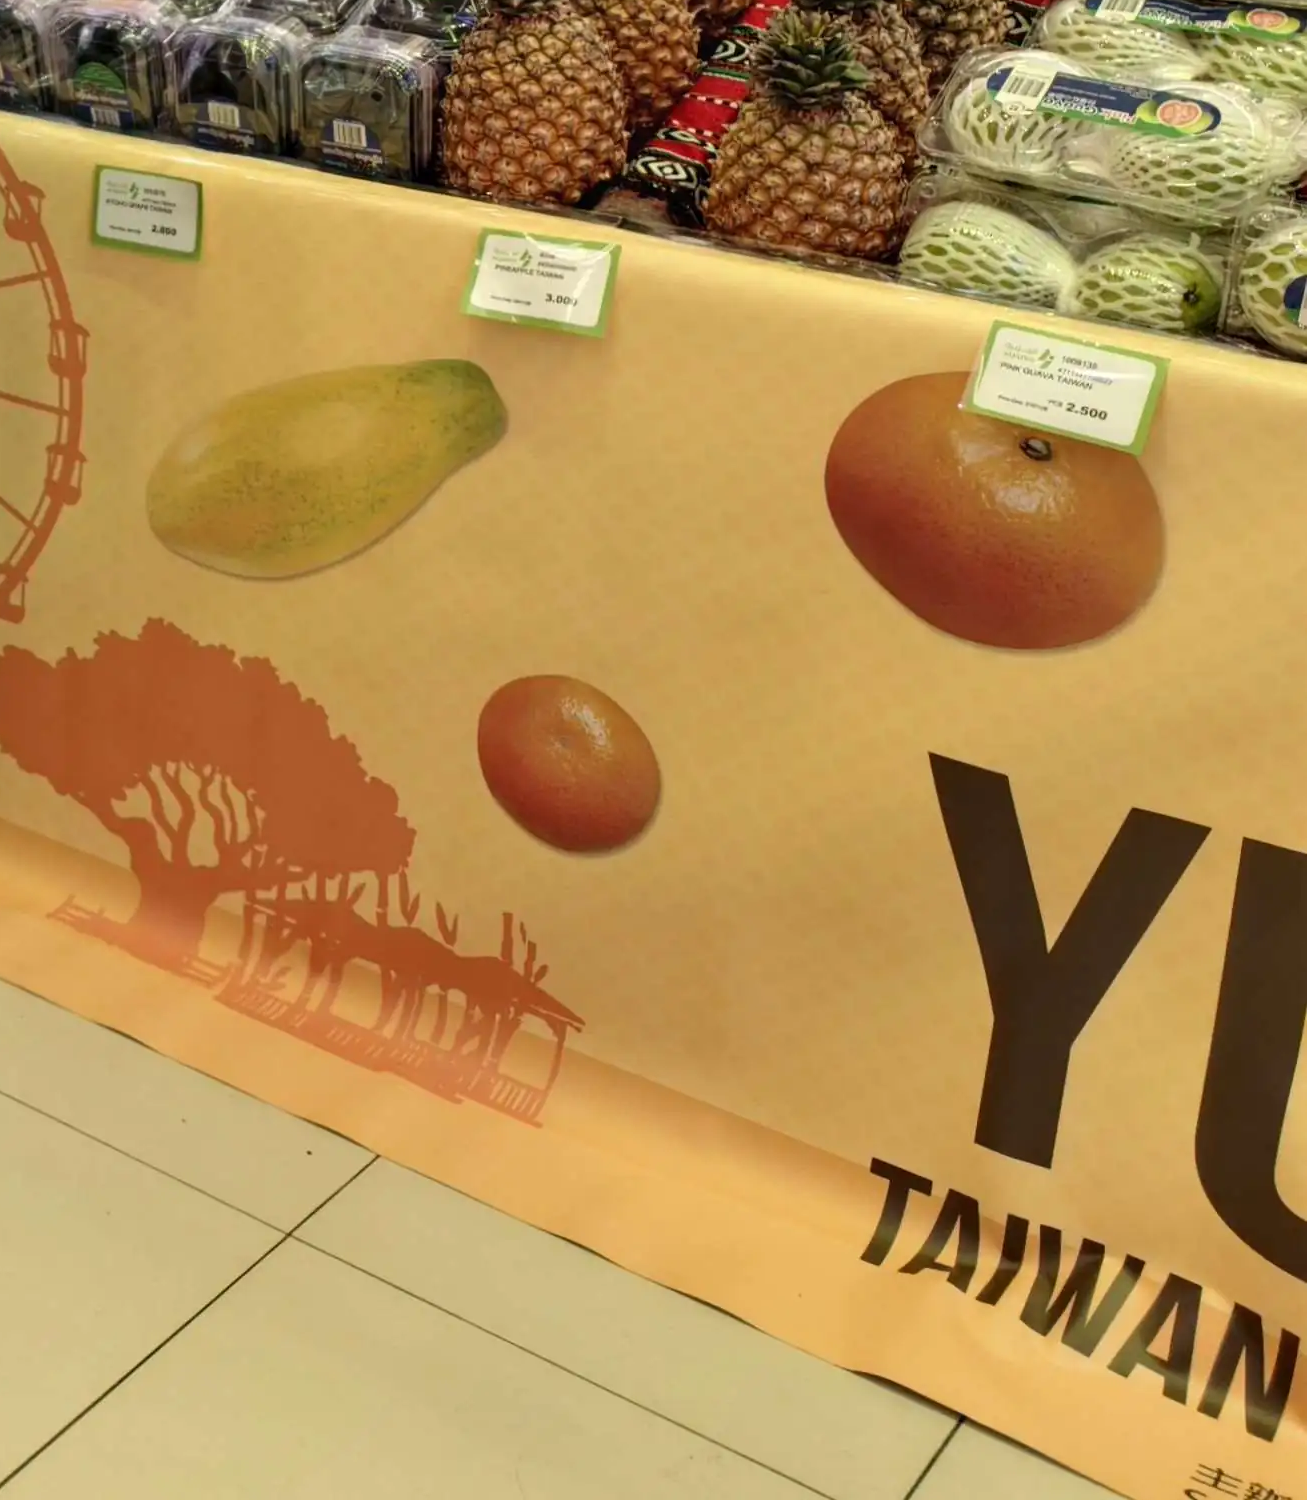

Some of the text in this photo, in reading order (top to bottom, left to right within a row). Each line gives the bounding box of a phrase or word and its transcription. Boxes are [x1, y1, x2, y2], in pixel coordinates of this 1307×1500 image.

[1042, 97, 1137, 124] Pink Guava
[999, 361, 1021, 375] PINK
[1022, 366, 1055, 382] GUAVA
[1057, 375, 1094, 391] TAIWAN
[1065, 401, 1109, 421] 2.500
[859, 1156, 1302, 1444] TAIWAN
